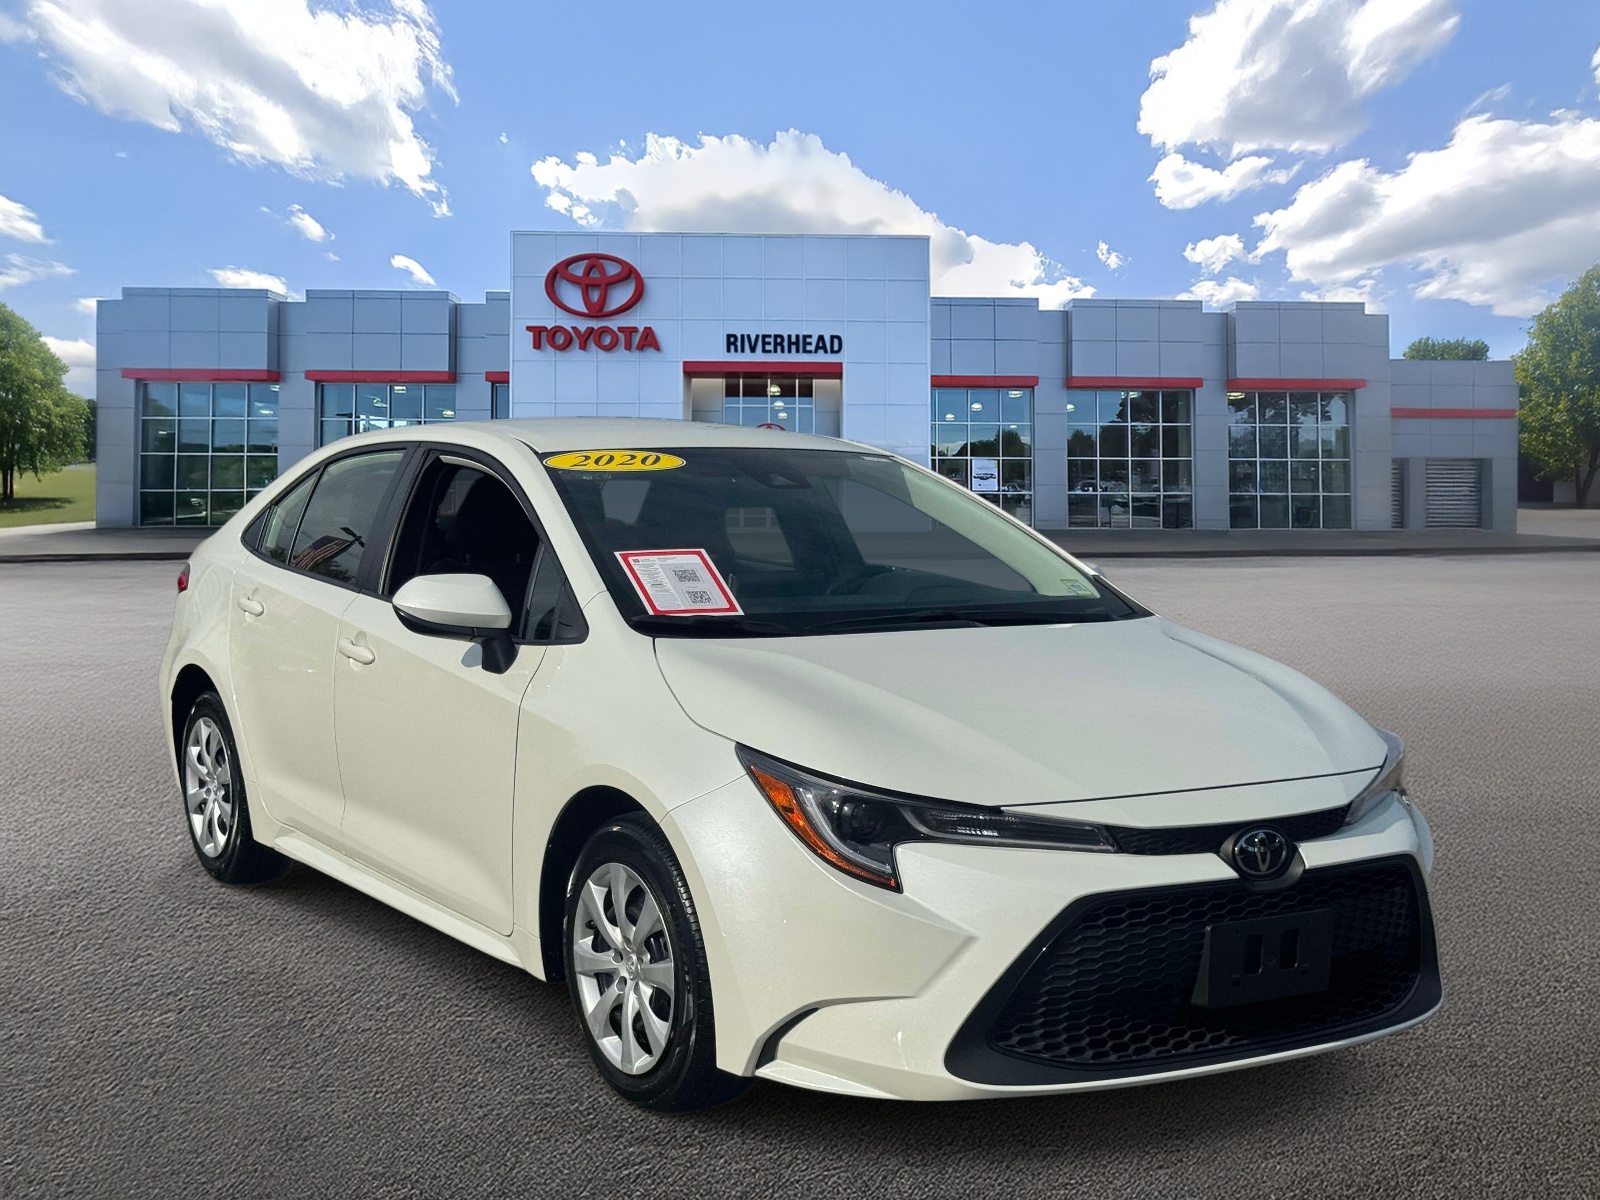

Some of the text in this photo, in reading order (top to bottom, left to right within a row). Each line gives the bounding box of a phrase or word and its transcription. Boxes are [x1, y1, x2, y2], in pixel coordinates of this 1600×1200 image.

[526, 325, 660, 351] TOYOTA
[725, 333, 843, 354] RIVERHEAD
[569, 454, 661, 467] 2020
